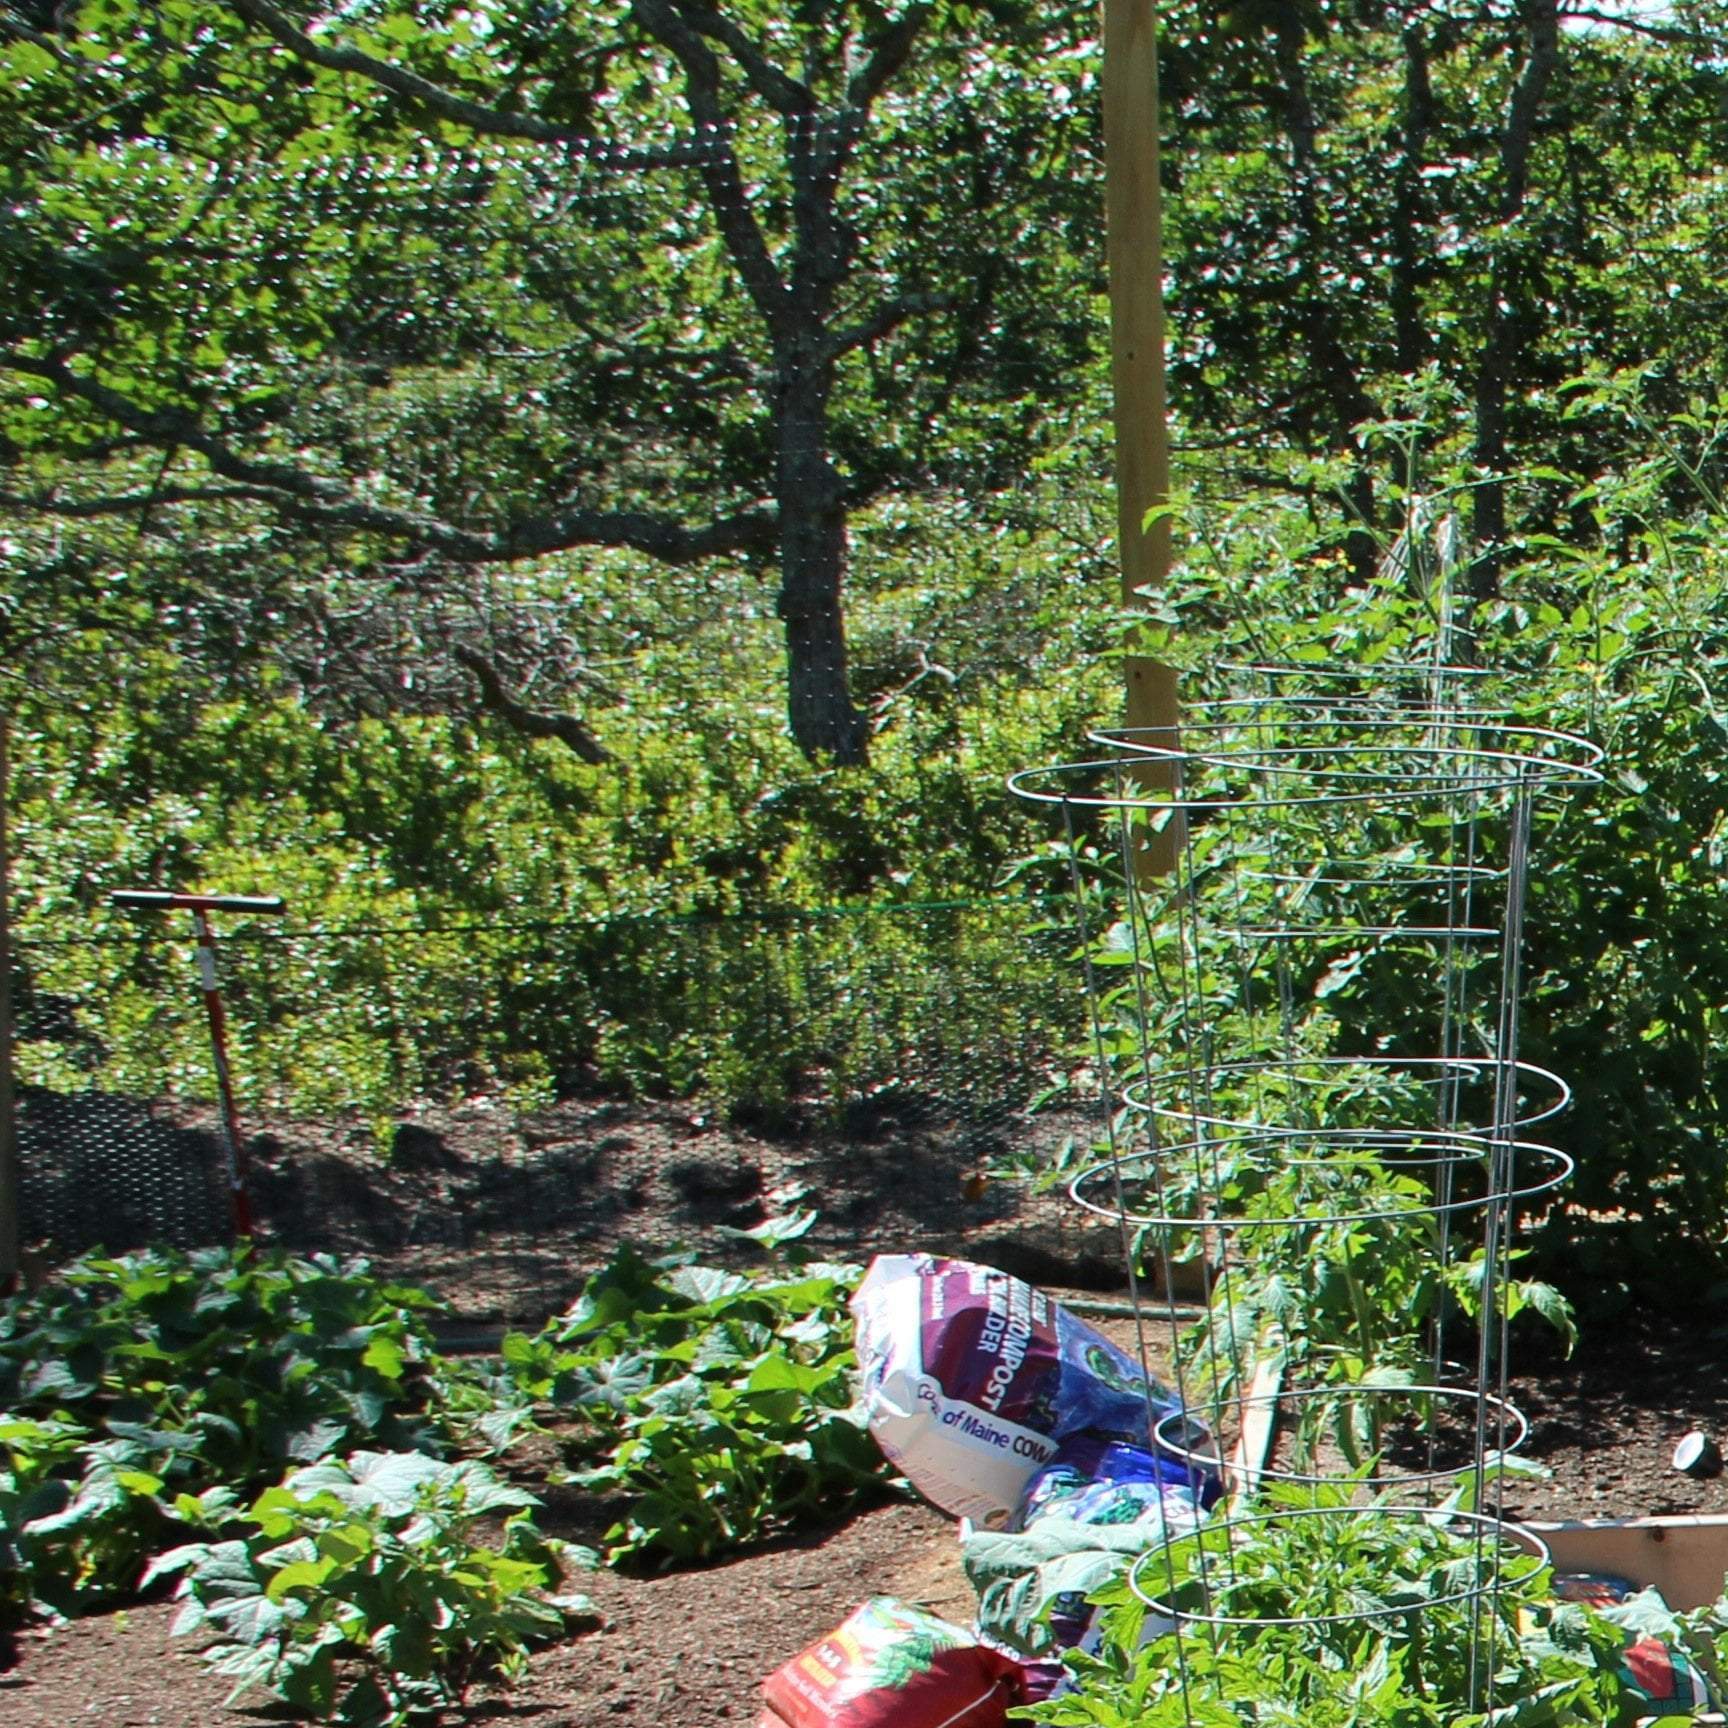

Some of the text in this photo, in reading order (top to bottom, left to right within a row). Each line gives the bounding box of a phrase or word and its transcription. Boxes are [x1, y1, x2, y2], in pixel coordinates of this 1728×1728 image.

[981, 1314, 1032, 1411] COMPOST
[943, 1410, 964, 1427] of
[963, 1415, 1011, 1449] Maine
